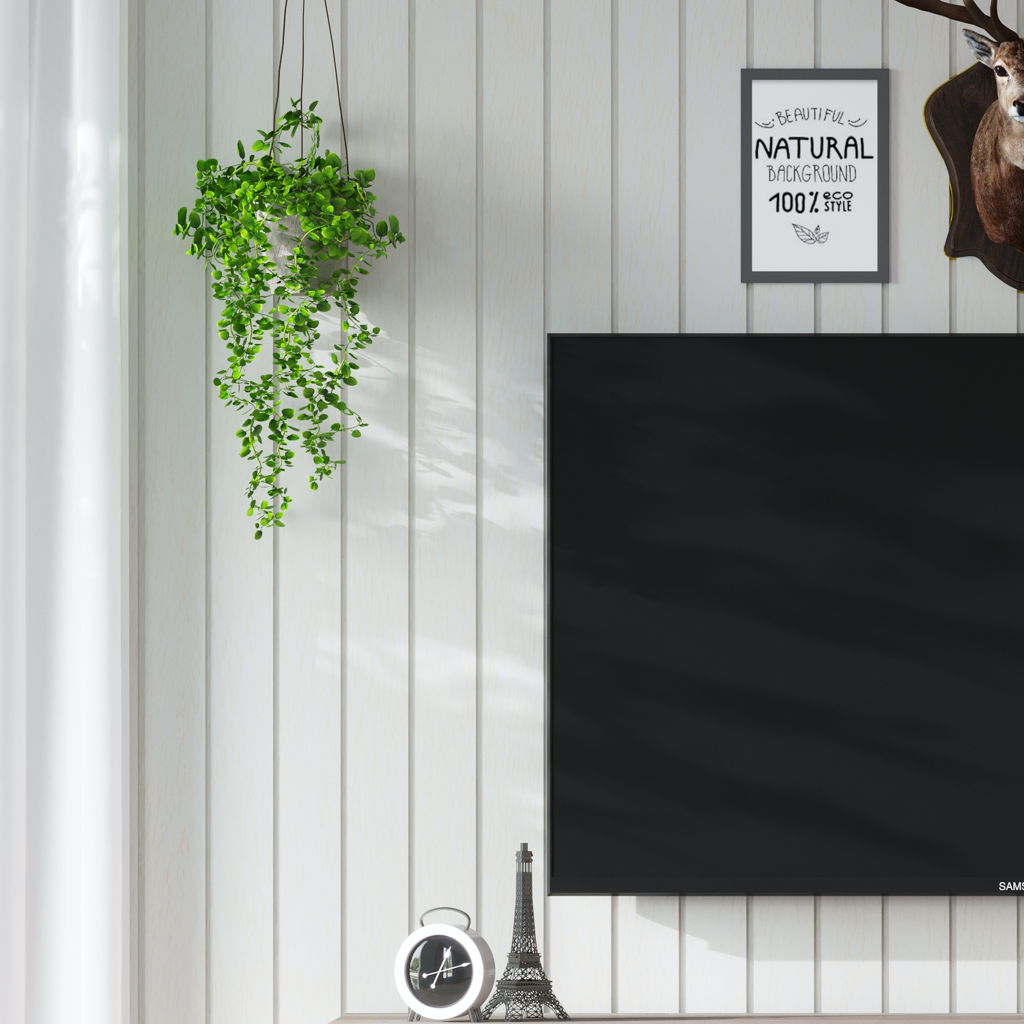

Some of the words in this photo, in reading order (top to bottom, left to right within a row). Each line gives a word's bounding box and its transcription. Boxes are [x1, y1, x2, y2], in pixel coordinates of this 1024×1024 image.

[775, 107, 845, 125] BEAUTIFUL
[755, 136, 874, 159] NATURAL
[766, 164, 857, 182] BACKGROUND
[769, 191, 819, 214] 100%
[824, 201, 852, 212] STYLE
